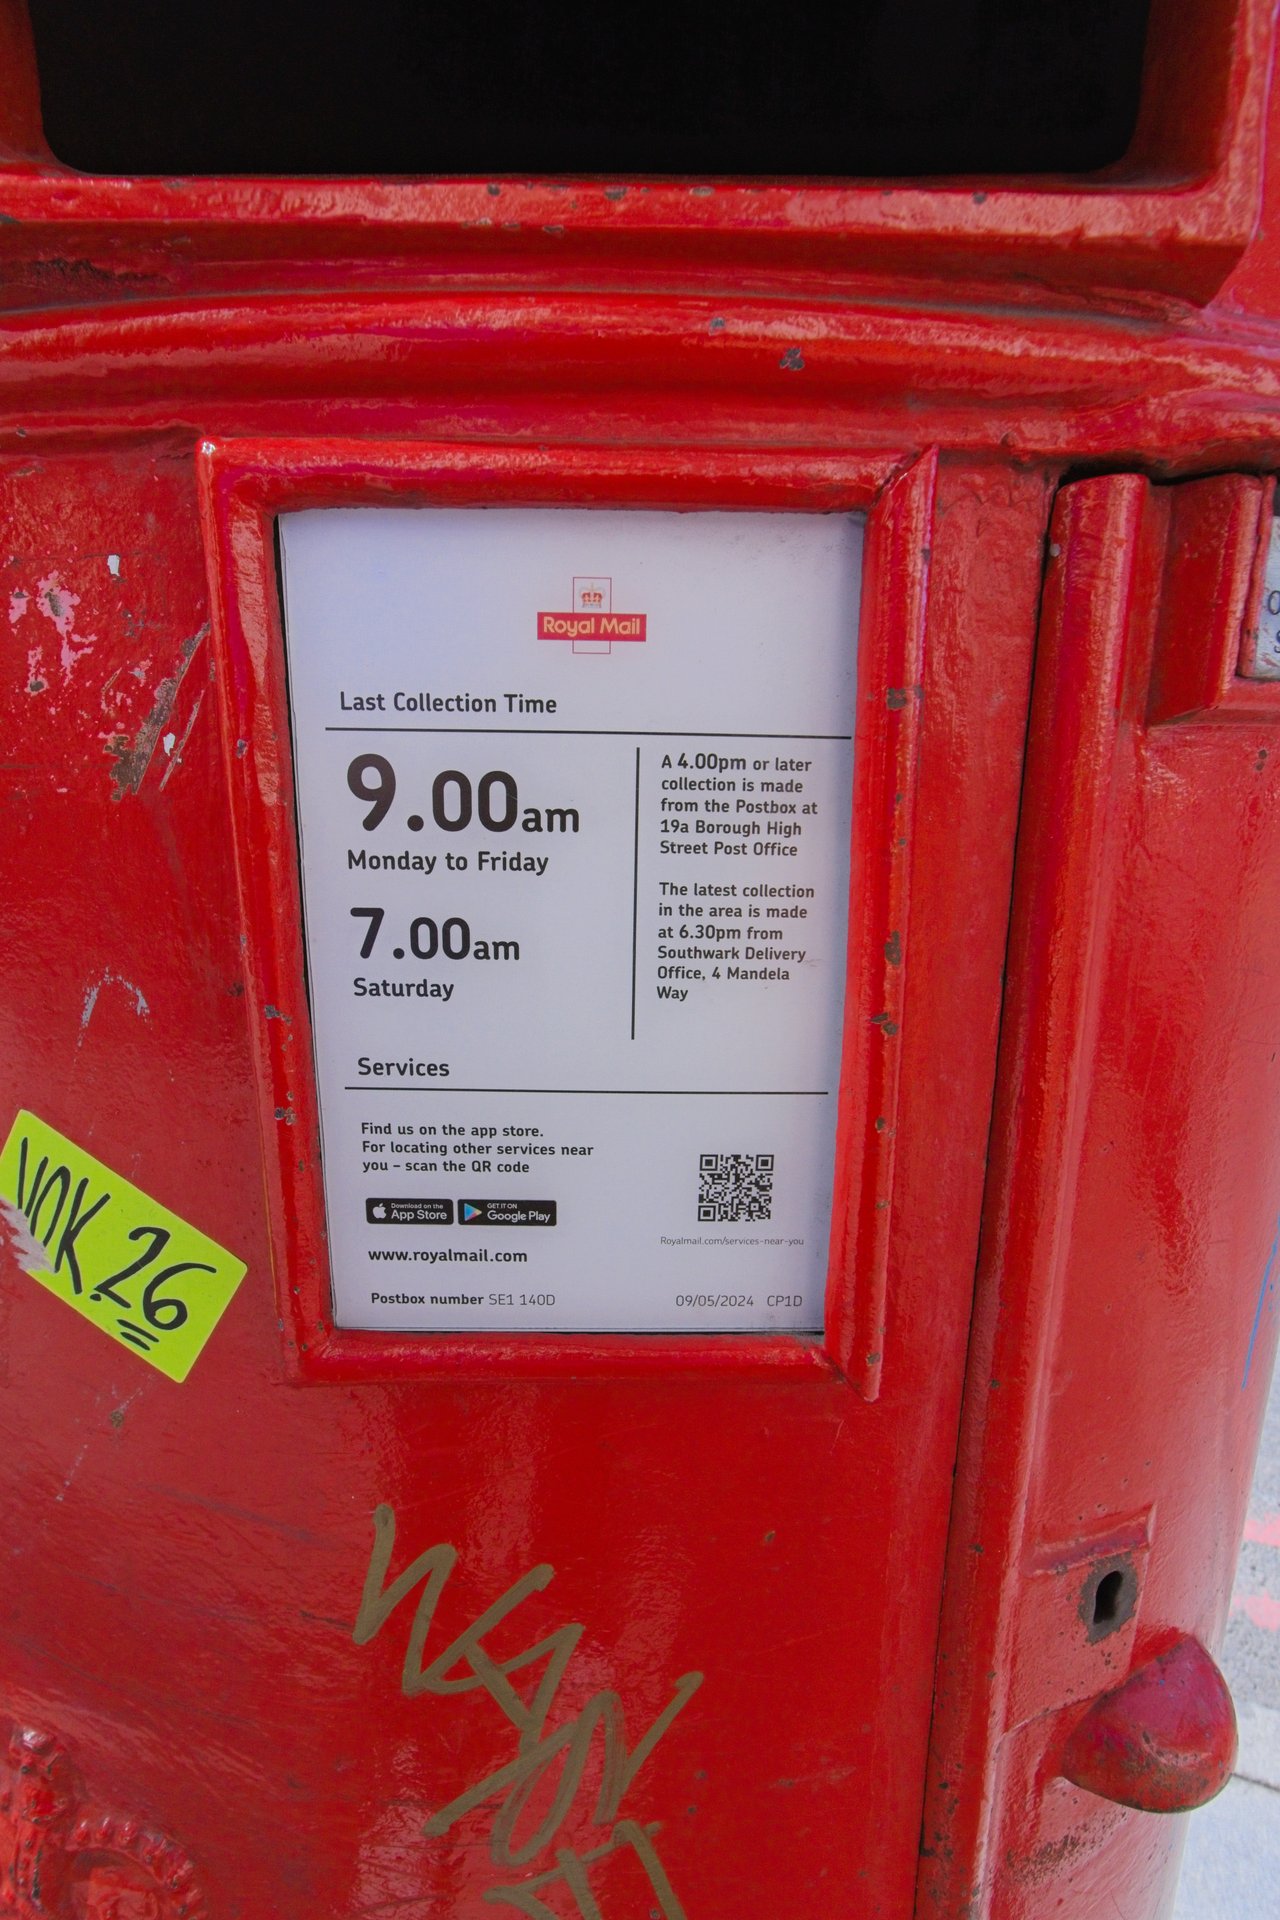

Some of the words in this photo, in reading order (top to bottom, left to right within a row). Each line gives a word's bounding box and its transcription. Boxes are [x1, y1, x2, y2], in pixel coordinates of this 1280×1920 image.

[543, 615, 595, 637] Royal
[599, 617, 640, 634] Mail
[340, 691, 385, 711] Last
[393, 691, 496, 712] Collection
[503, 693, 556, 713] Time
[661, 754, 672, 768] A
[677, 752, 746, 773] 4.00pm
[752, 759, 769, 770] or
[775, 756, 812, 771] later
[346, 753, 579, 832] 9.00am
[661, 776, 735, 791] collection
[742, 777, 754, 791] is
[760, 778, 803, 793] made
[660, 797, 698, 811] from
[704, 798, 729, 812] the
[735, 798, 796, 814] Postbox
[801, 802, 817, 814] at
[660, 818, 688, 833] 19a
[695, 819, 760, 837] Borough
[766, 820, 801, 838] High
[659, 839, 708, 854] Street
[714, 840, 747, 855] Post
[753, 841, 797, 856] Office
[347, 849, 436, 875] Monday
[444, 852, 467, 870] to
[477, 850, 548, 876] Friday
[658, 881, 687, 895] The
[693, 882, 737, 896] latest
[742, 883, 814, 898] collection
[658, 902, 672, 916] in
[678, 903, 703, 916] the
[708, 906, 742, 917] area
[748, 903, 760, 917] is
[766, 904, 807, 918] made
[349, 907, 519, 960] 7.00am
[657, 926, 673, 938] at
[678, 924, 740, 942] 6.30pm
[746, 926, 782, 939] from
[657, 945, 739, 959] Southwark
[745, 946, 806, 963] Delivery
[657, 965, 705, 980] Office,
[711, 966, 720, 979] 4
[727, 966, 789, 980] Mandela
[353, 977, 454, 1001] Saturday
[656, 985, 688, 1001] Way
[357, 1056, 449, 1076] Services
[361, 1122, 392, 1134] Find
[397, 1125, 413, 1135] us
[419, 1126, 436, 1135] on
[441, 1123, 465, 1135] the
[470, 1126, 497, 1138] app
[502, 1125, 543, 1136] store.
[362, 1140, 385, 1152] For
[390, 1141, 447, 1156] locating
[452, 1142, 492, 1154] other
[496, 1142, 555, 1155] services
[560, 1146, 593, 1155] near
[362, 1161, 388, 1173] you
[405, 1162, 437, 1171] scan
[442, 1159, 465, 1171] the
[471, 1160, 491, 1172] QR
[496, 1160, 529, 1172] code
[391, 1209, 415, 1221] App
[417, 1209, 447, 1220] Store
[487, 1210, 527, 1223] Google
[528, 1210, 551, 1223] Play
[660, 1236, 805, 1247] Royalmail.com/services-near-you
[367, 1248, 527, 1264] www.royalmail.com
[371, 1292, 425, 1304] Postbox
[429, 1293, 484, 1304] number
[488, 1293, 514, 1305] SE1
[519, 1293, 555, 1305] 140D
[675, 1294, 753, 1307] 09/05/2024
[766, 1294, 802, 1307] CP1D
